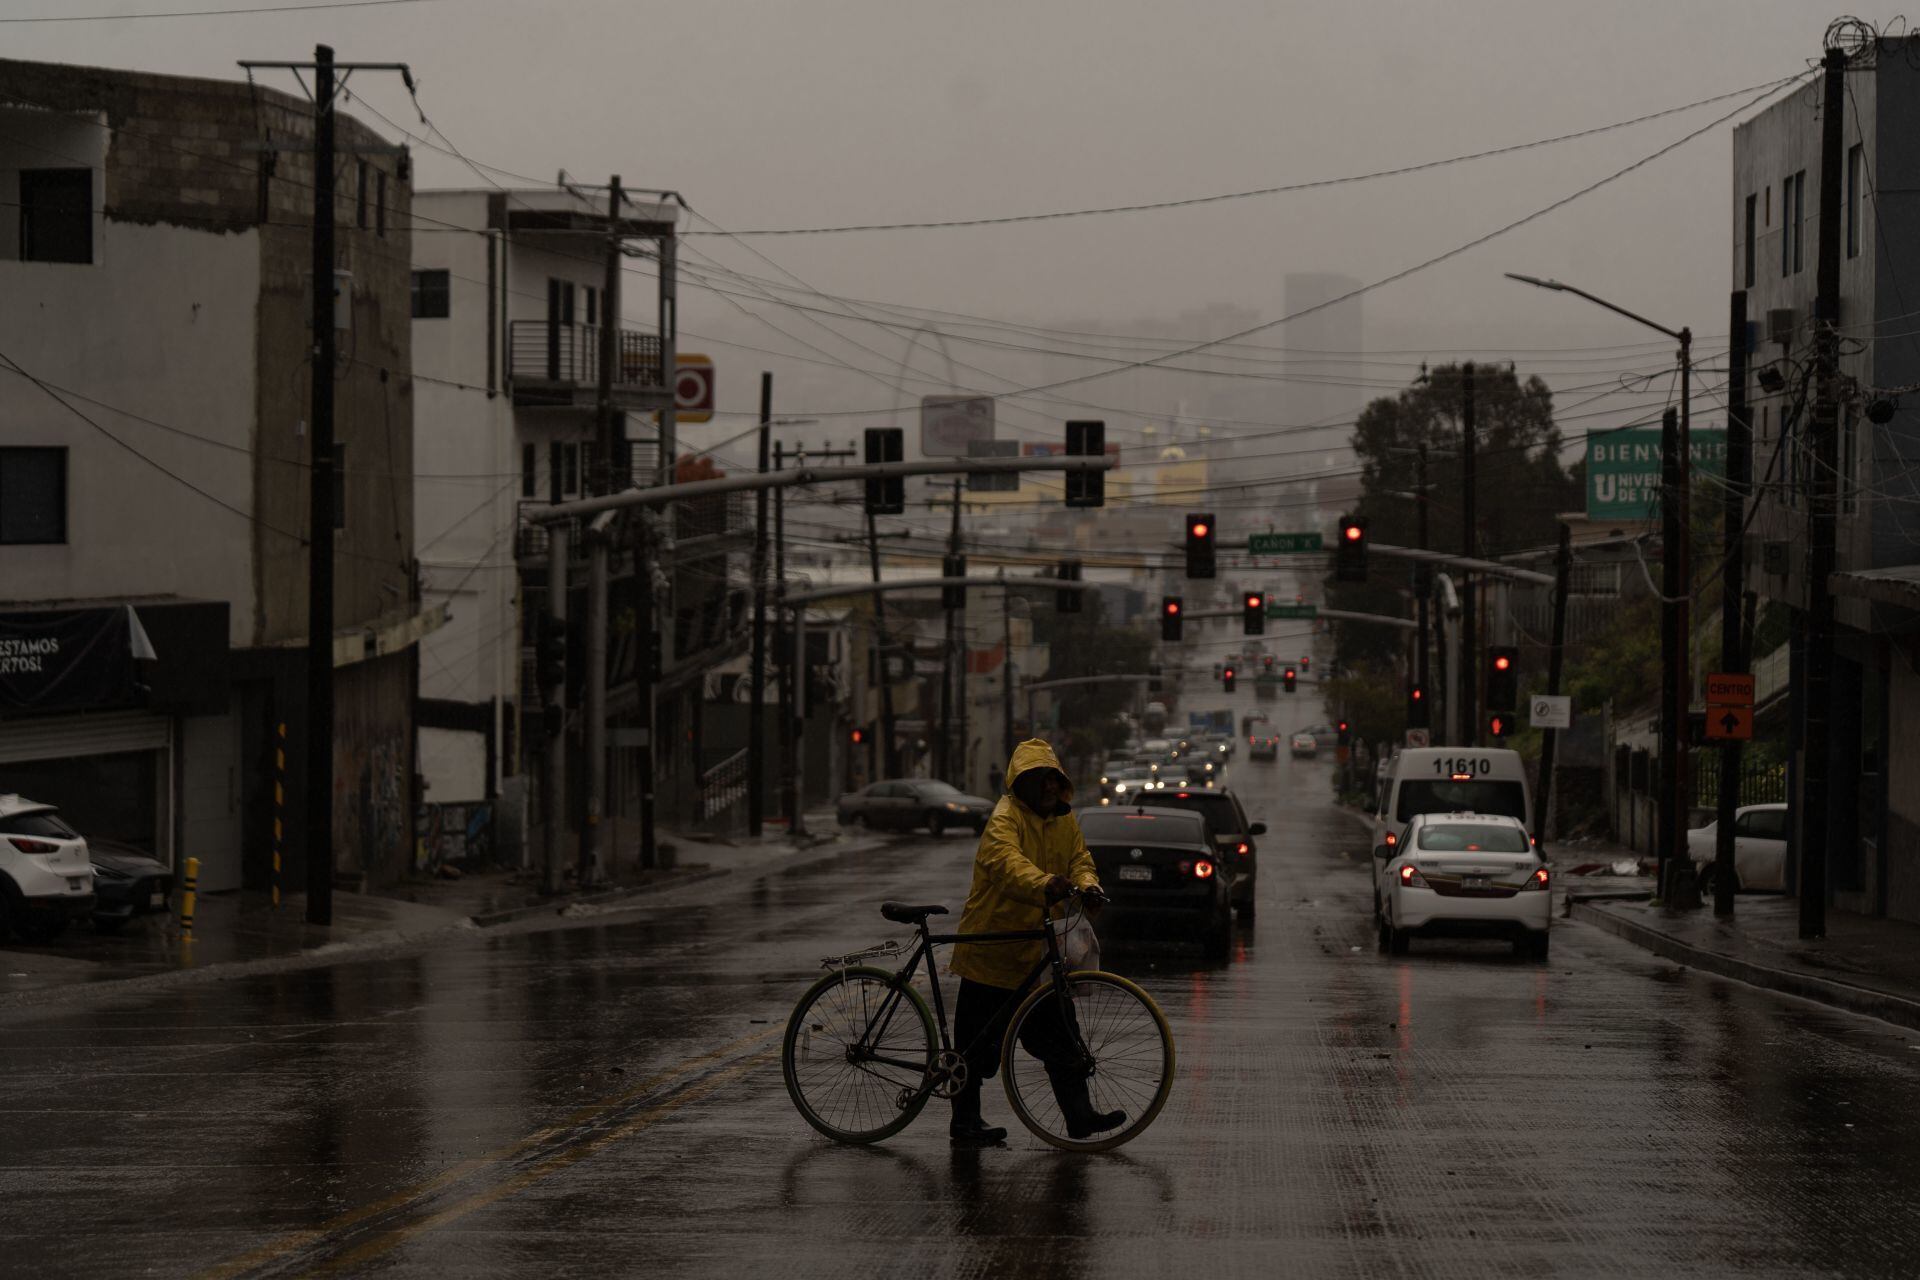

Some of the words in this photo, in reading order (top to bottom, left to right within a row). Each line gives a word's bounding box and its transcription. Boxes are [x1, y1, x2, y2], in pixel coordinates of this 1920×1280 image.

[1618, 488, 1636, 502] DE
[0, 637, 59, 656] ESTAMOS
[0, 654, 42, 673] RTOS!
[1710, 683, 1752, 696] CENTRO
[1433, 758, 1490, 775] 11610
